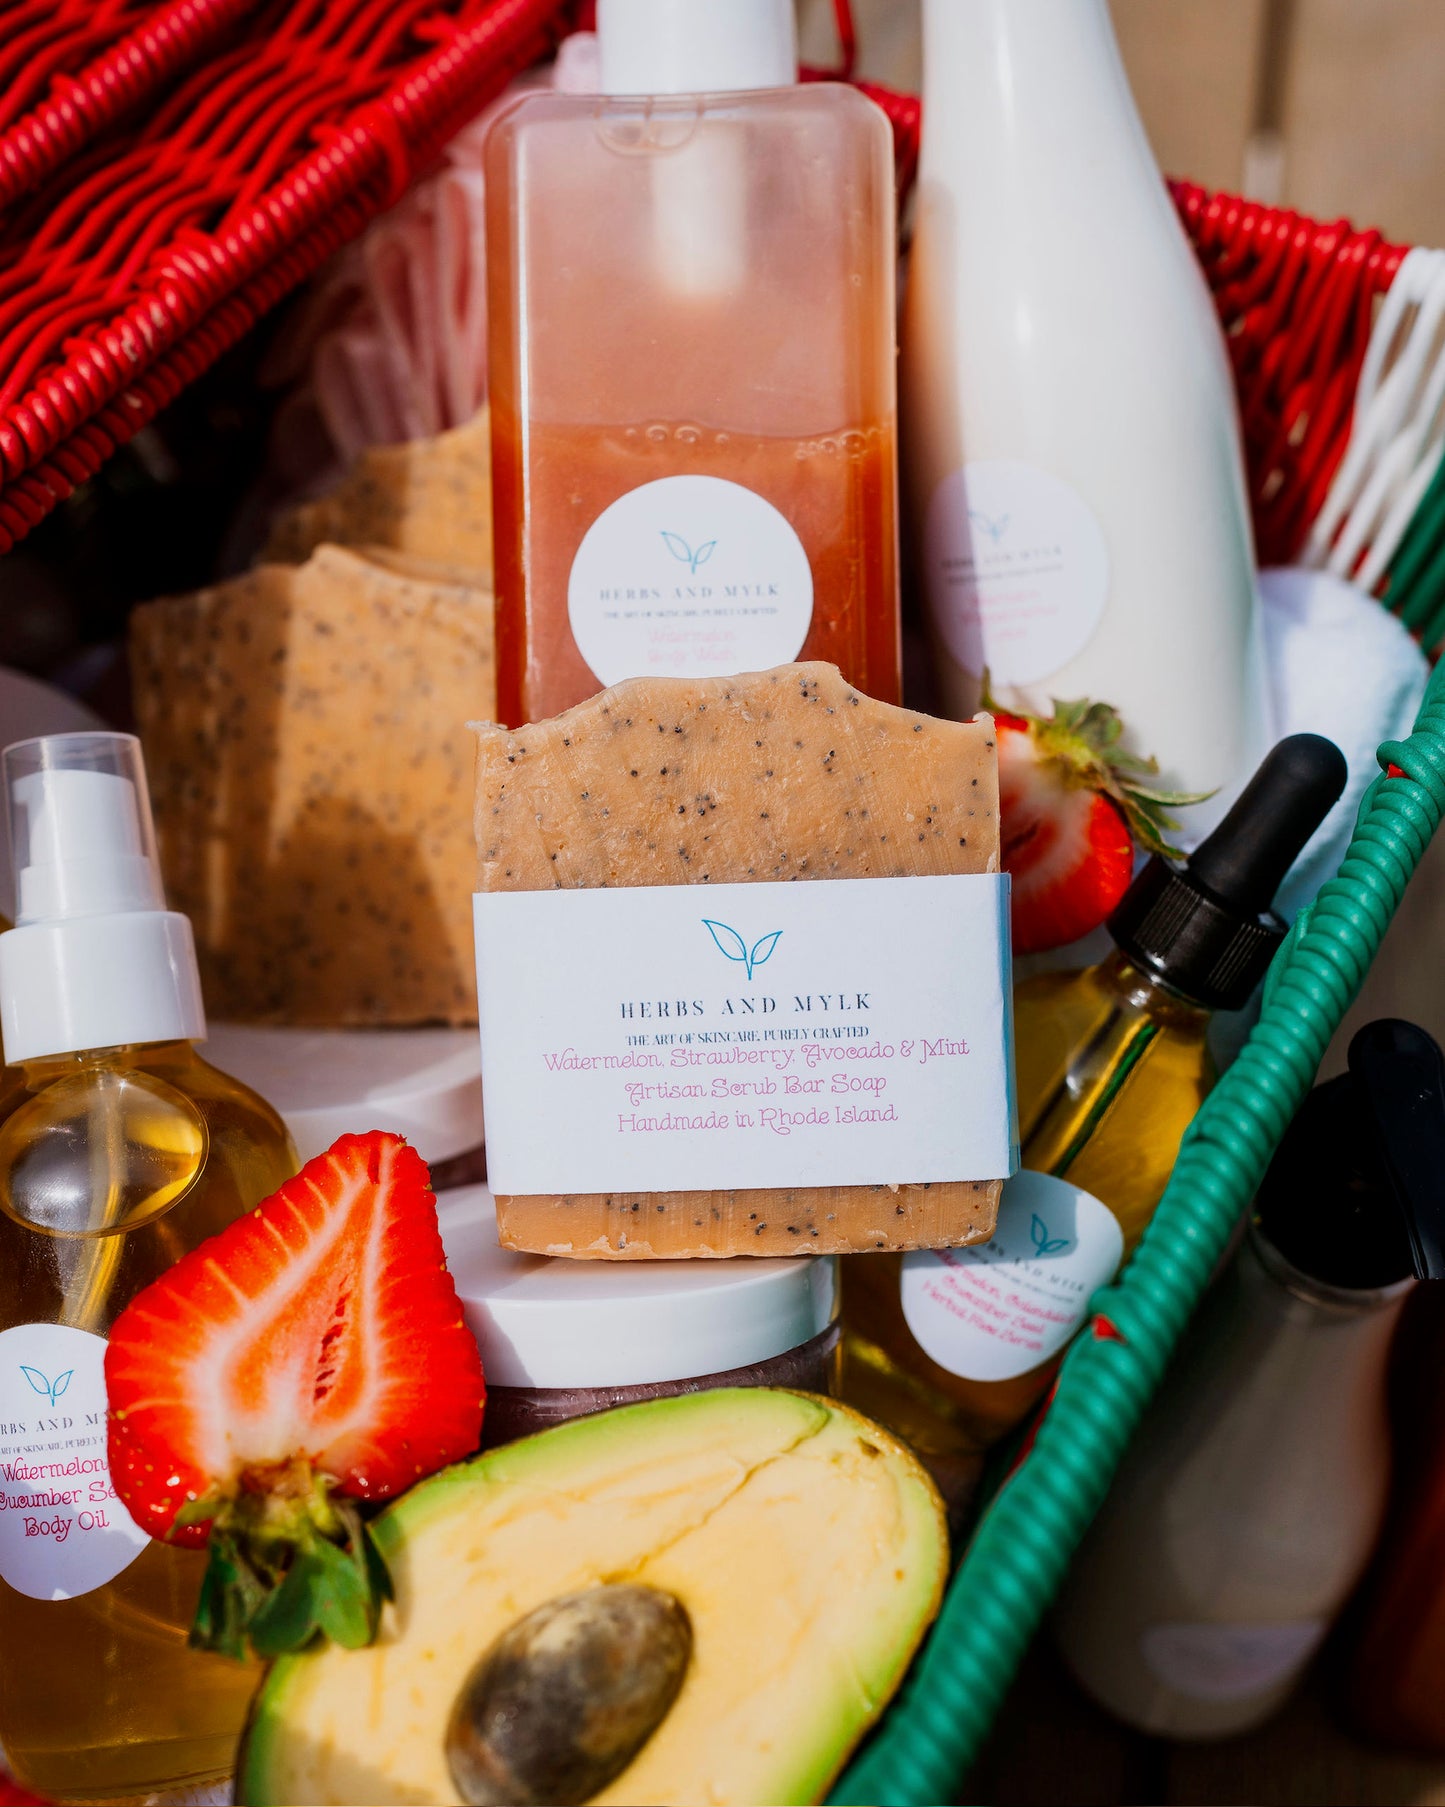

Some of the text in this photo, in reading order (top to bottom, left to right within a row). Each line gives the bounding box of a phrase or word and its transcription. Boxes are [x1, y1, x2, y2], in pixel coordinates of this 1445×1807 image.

[673, 586, 712, 599] AND
[724, 583, 779, 597] MYLK
[621, 993, 871, 1019] HERBS AND MYLK
[625, 1034, 650, 1046] THE
[652, 1032, 677, 1046] ART
[679, 1031, 696, 1044] OF
[764, 1027, 810, 1041] PURELY
[812, 1025, 870, 1039] CRAFTED
[542, 1038, 970, 1071] Watermelon, Strawberry, Avocado & Mint
[624, 1073, 887, 1107] Artisan Scrub Bar Soap
[617, 1103, 899, 1136] Handmade in Rhode Island
[0, 1422, 26, 1435] RBS
[36, 1417, 73, 1432] AND
[88, 1480, 117, 1502] Se
[23, 1509, 110, 1543] Body Oil
